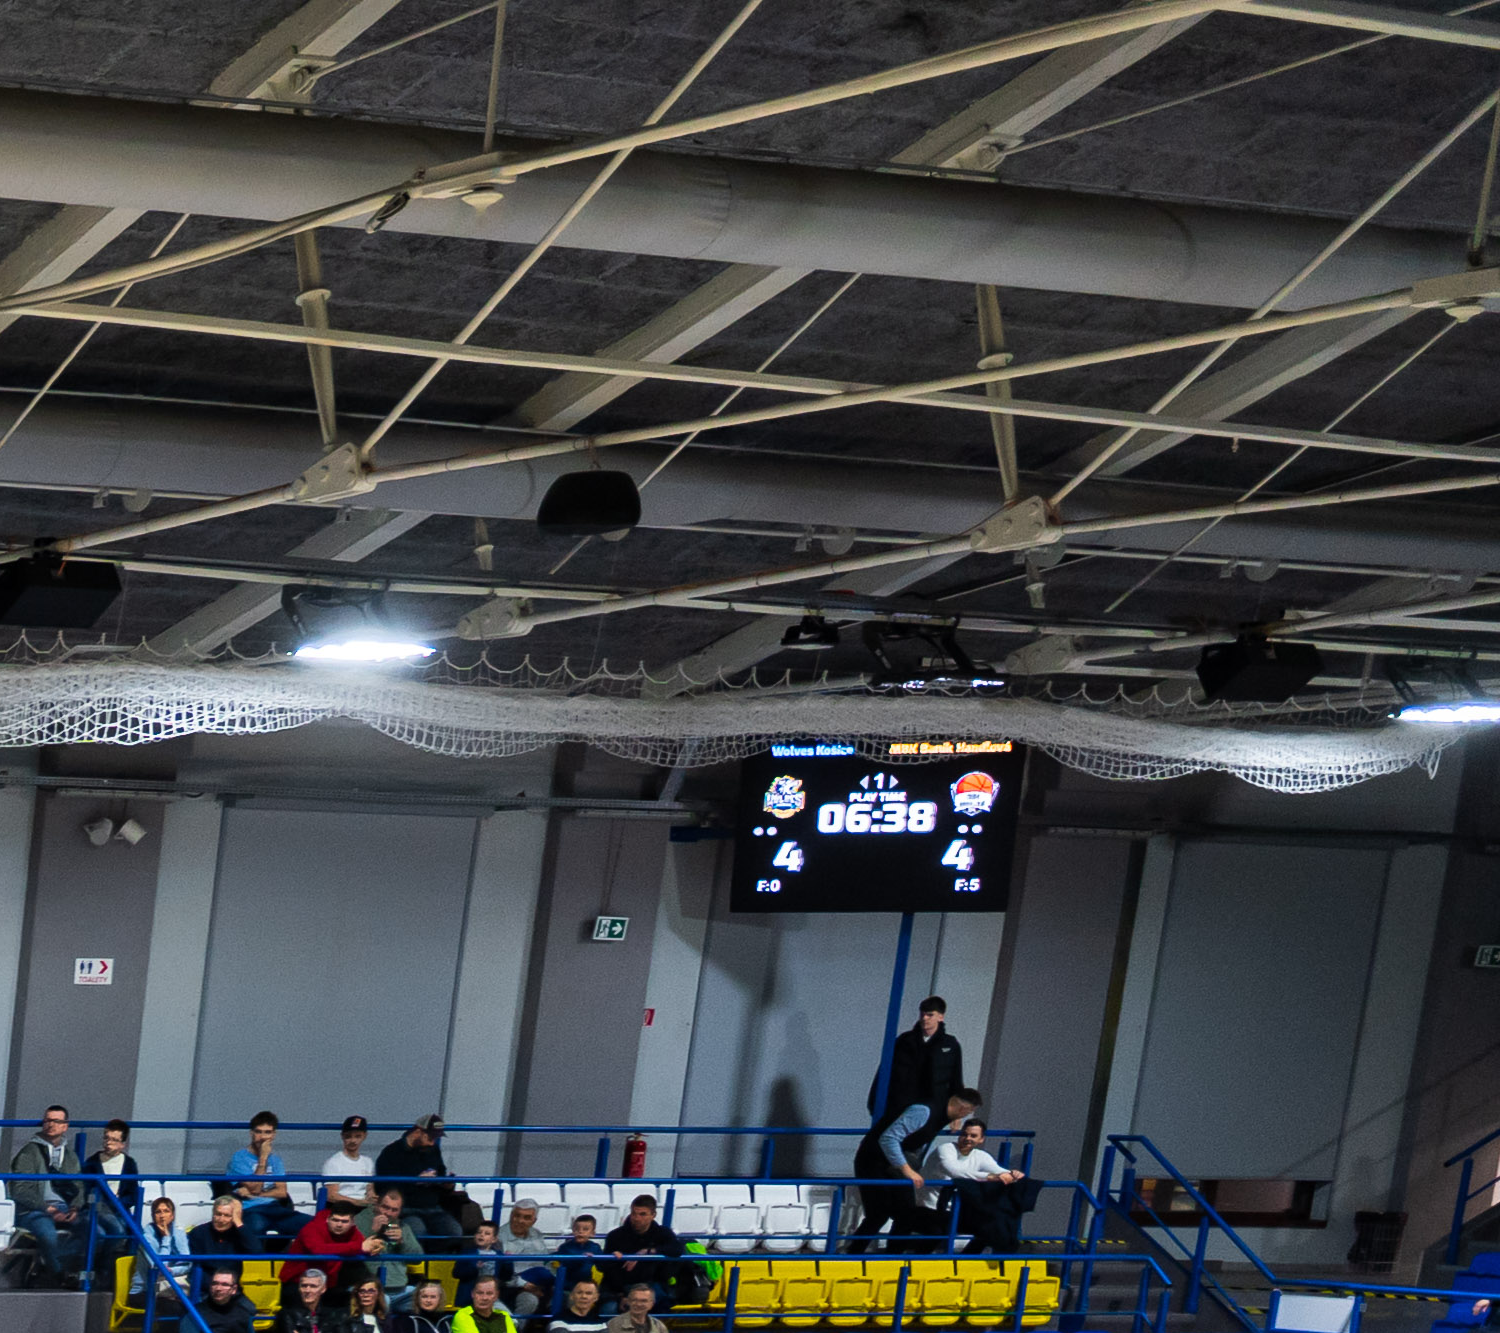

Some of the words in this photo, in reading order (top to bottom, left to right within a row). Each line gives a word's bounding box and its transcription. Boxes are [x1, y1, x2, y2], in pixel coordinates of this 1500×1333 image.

[771, 745, 814, 757] Wolves
[874, 773, 884, 789] 1
[848, 792, 877, 803] PLAY
[879, 792, 906, 802] TIME
[817, 801, 937, 834] 06:38
[772, 840, 804, 872] 4
[941, 840, 974, 871] 4
[756, 880, 781, 892] F:0
[954, 879, 980, 892] F:5
